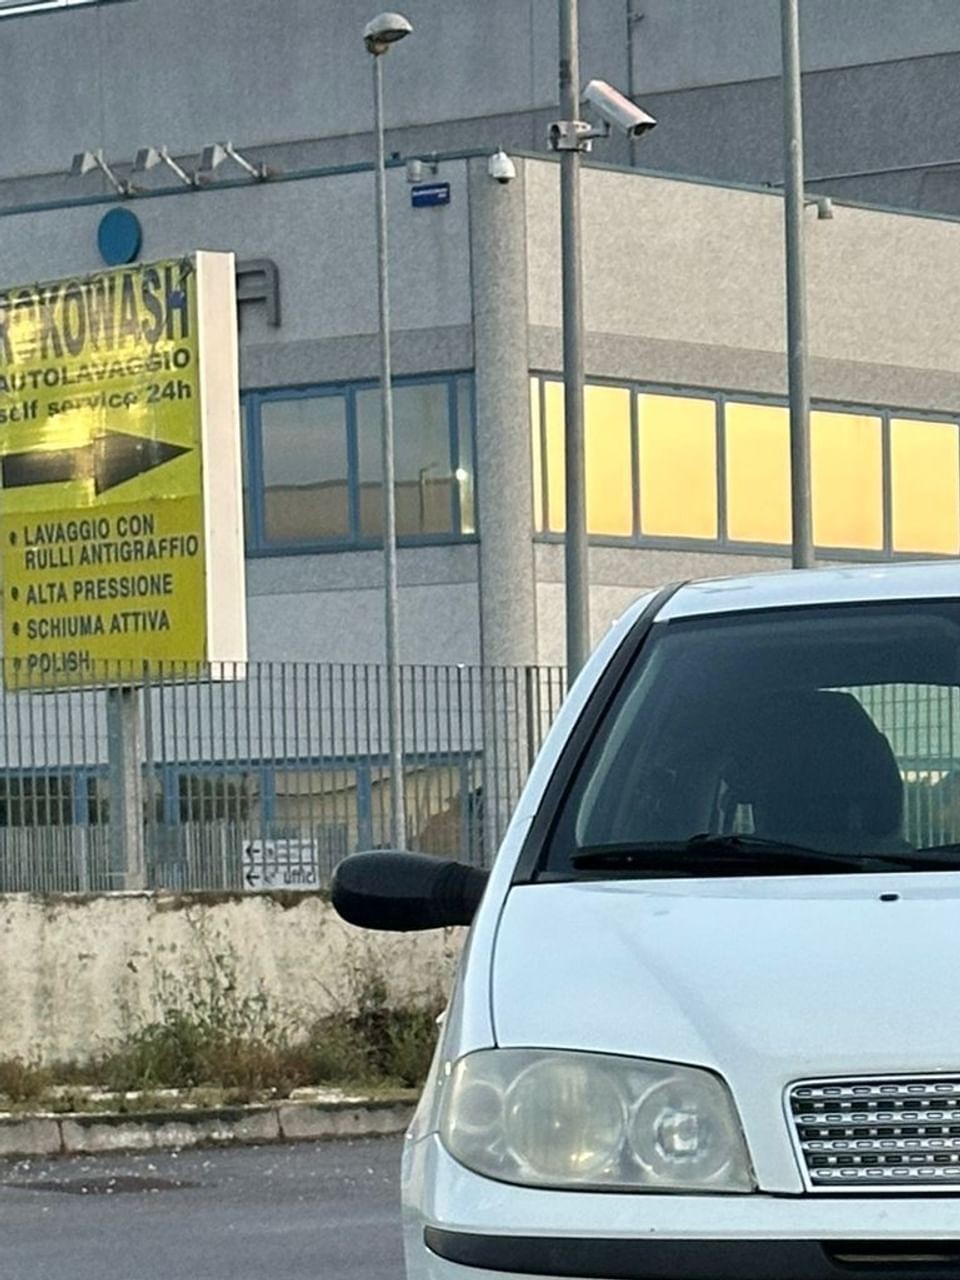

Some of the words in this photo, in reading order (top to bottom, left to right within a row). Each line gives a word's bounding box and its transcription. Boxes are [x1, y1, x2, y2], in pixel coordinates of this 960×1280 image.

[0, 399, 38, 423] self
[146, 379, 192, 404] 24h
[23, 517, 110, 547] LAVAGGIO
[116, 513, 154, 537] CON
[25, 545, 75, 570] RULLI
[79, 534, 199, 566] ANTIGRAFFIO
[26, 581, 68, 605] ALTA
[73, 573, 173, 601] PRESSIONE
[26, 613, 105, 640] SCHIUMA
[109, 609, 170, 634] ATTIVA
[27, 650, 90, 673] POLISH
